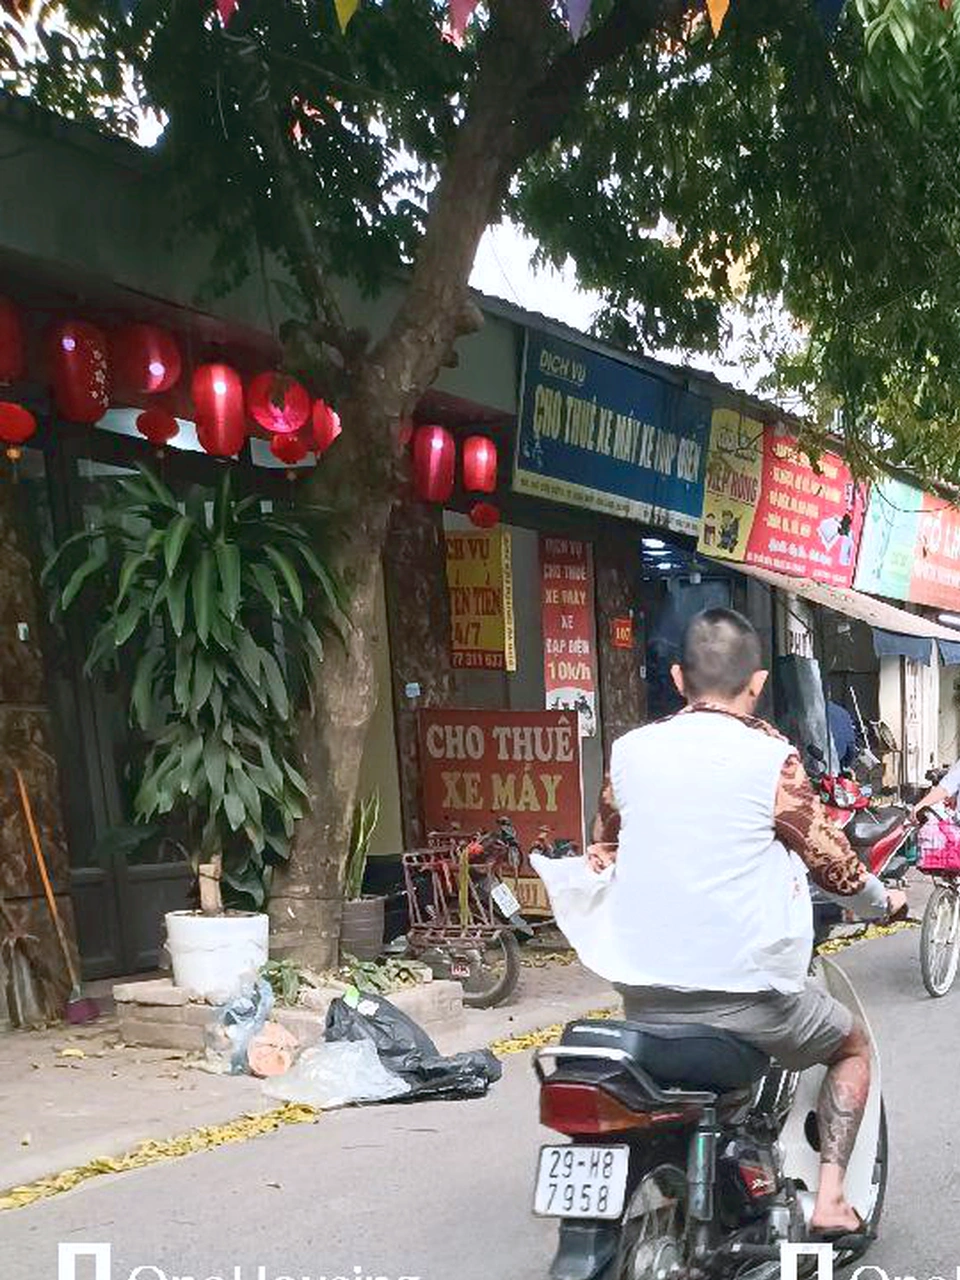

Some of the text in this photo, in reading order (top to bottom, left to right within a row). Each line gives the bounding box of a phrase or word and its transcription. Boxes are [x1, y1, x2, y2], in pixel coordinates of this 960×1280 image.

[533, 384, 562, 440] CHO
[596, 407, 613, 456] XE
[545, 588, 560, 604] XE
[561, 614, 574, 629] XE
[426, 714, 574, 762] CHO THUÊ
[441, 762, 563, 812] XE MÁY
[549, 1150, 614, 1179] 29-H8
[546, 1183, 609, 1212] 7958
